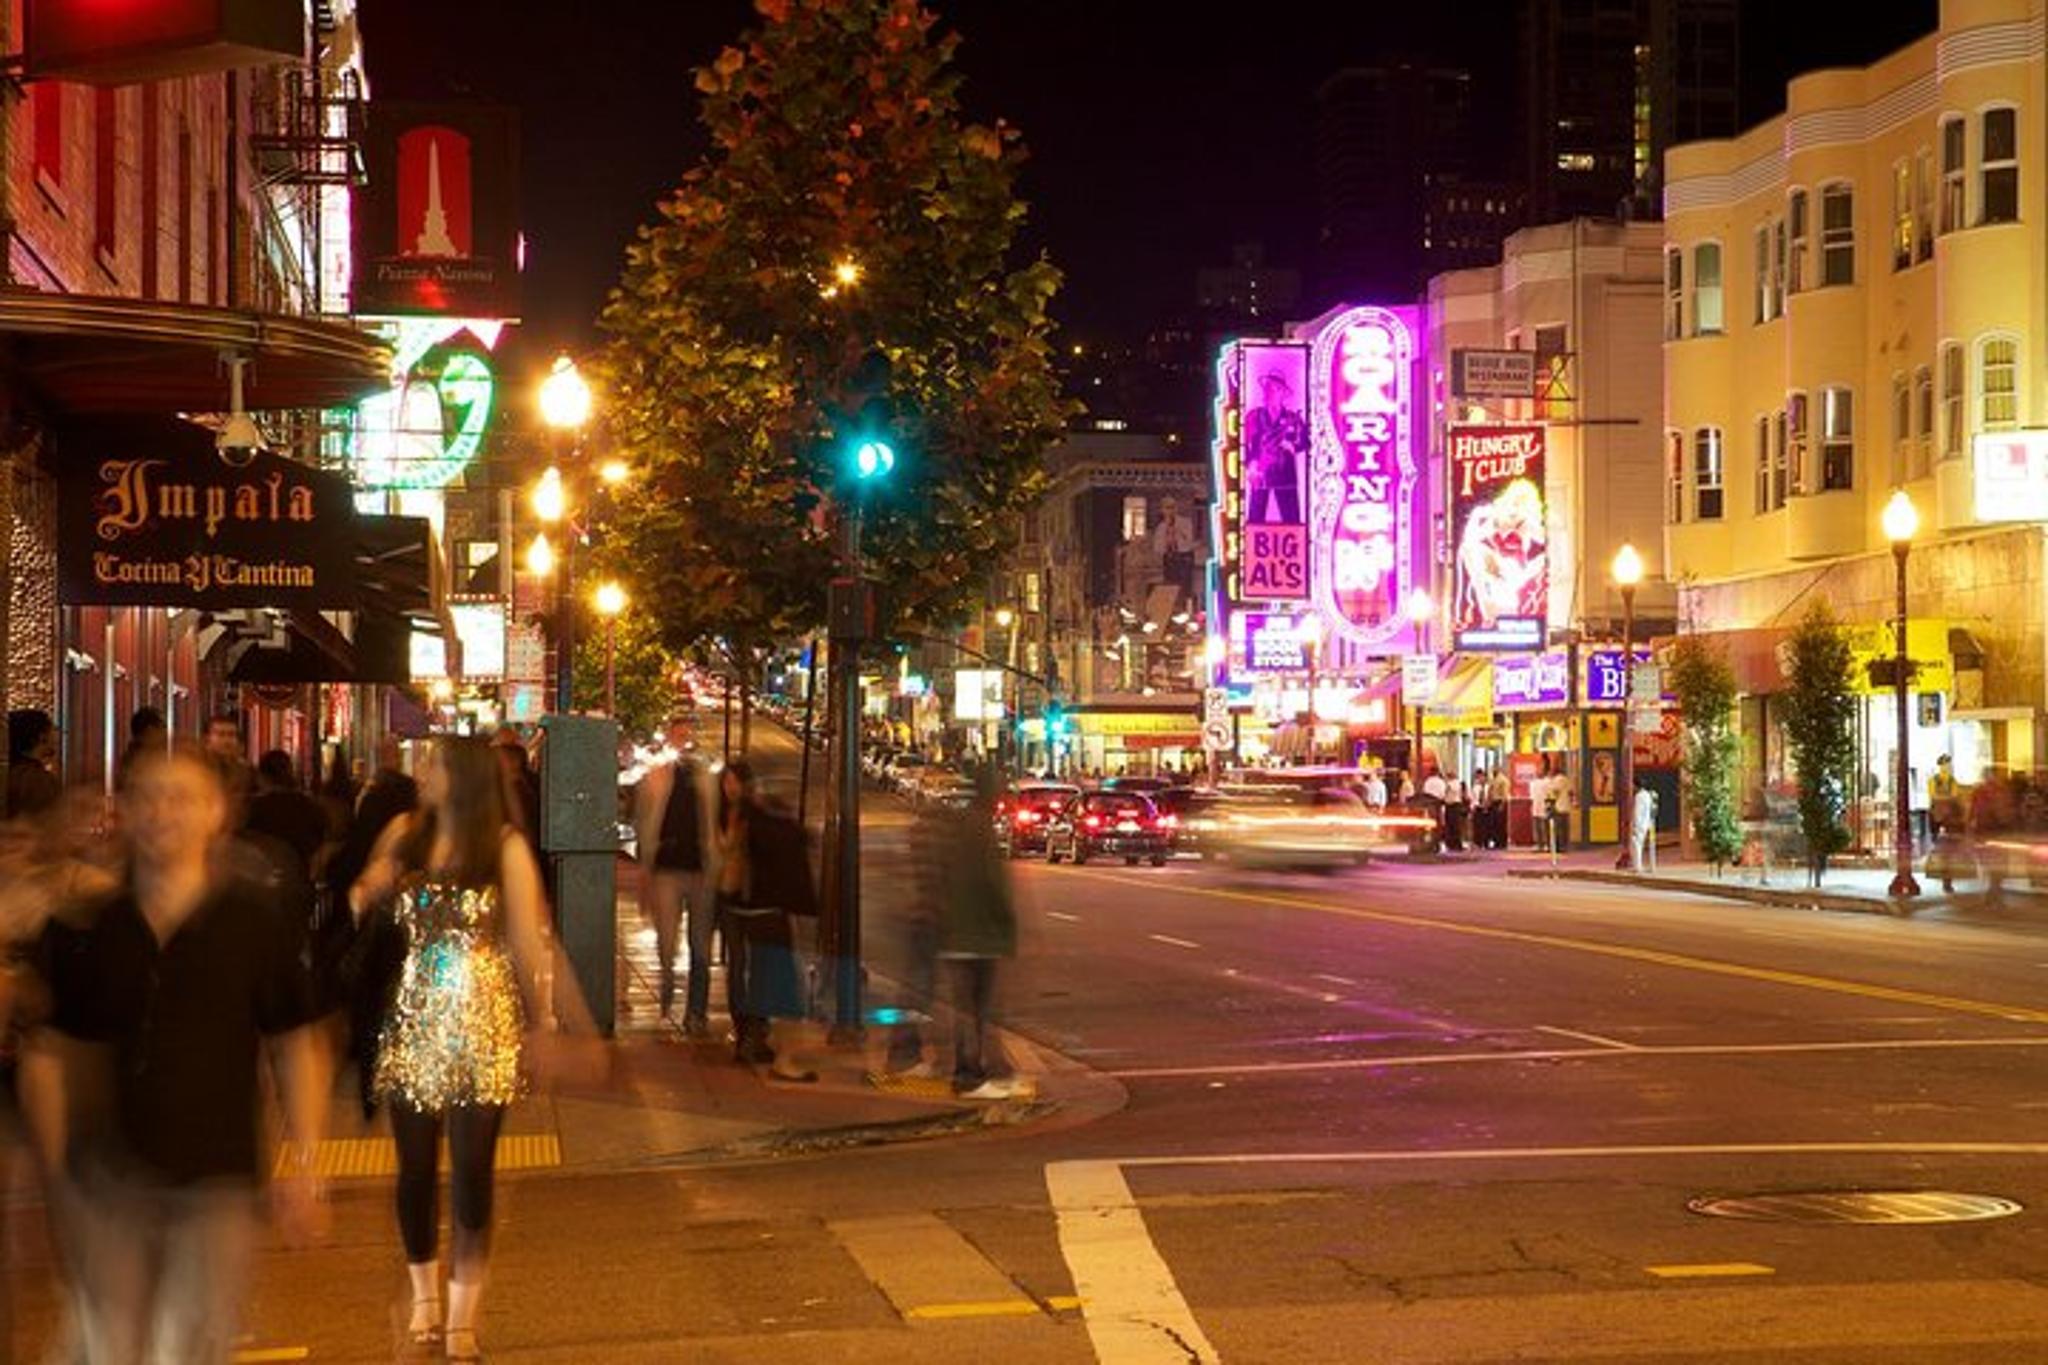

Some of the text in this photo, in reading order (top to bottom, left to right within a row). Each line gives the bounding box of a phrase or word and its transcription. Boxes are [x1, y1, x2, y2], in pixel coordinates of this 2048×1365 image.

[1455, 432, 1542, 460] HUNGRY
[1460, 453, 1526, 496] I CLUB
[97, 460, 315, 540] Impala
[1253, 530, 1299, 558] BIG
[94, 552, 315, 592] Cocina Y Cantina
[1248, 557, 1303, 588] AL'S
